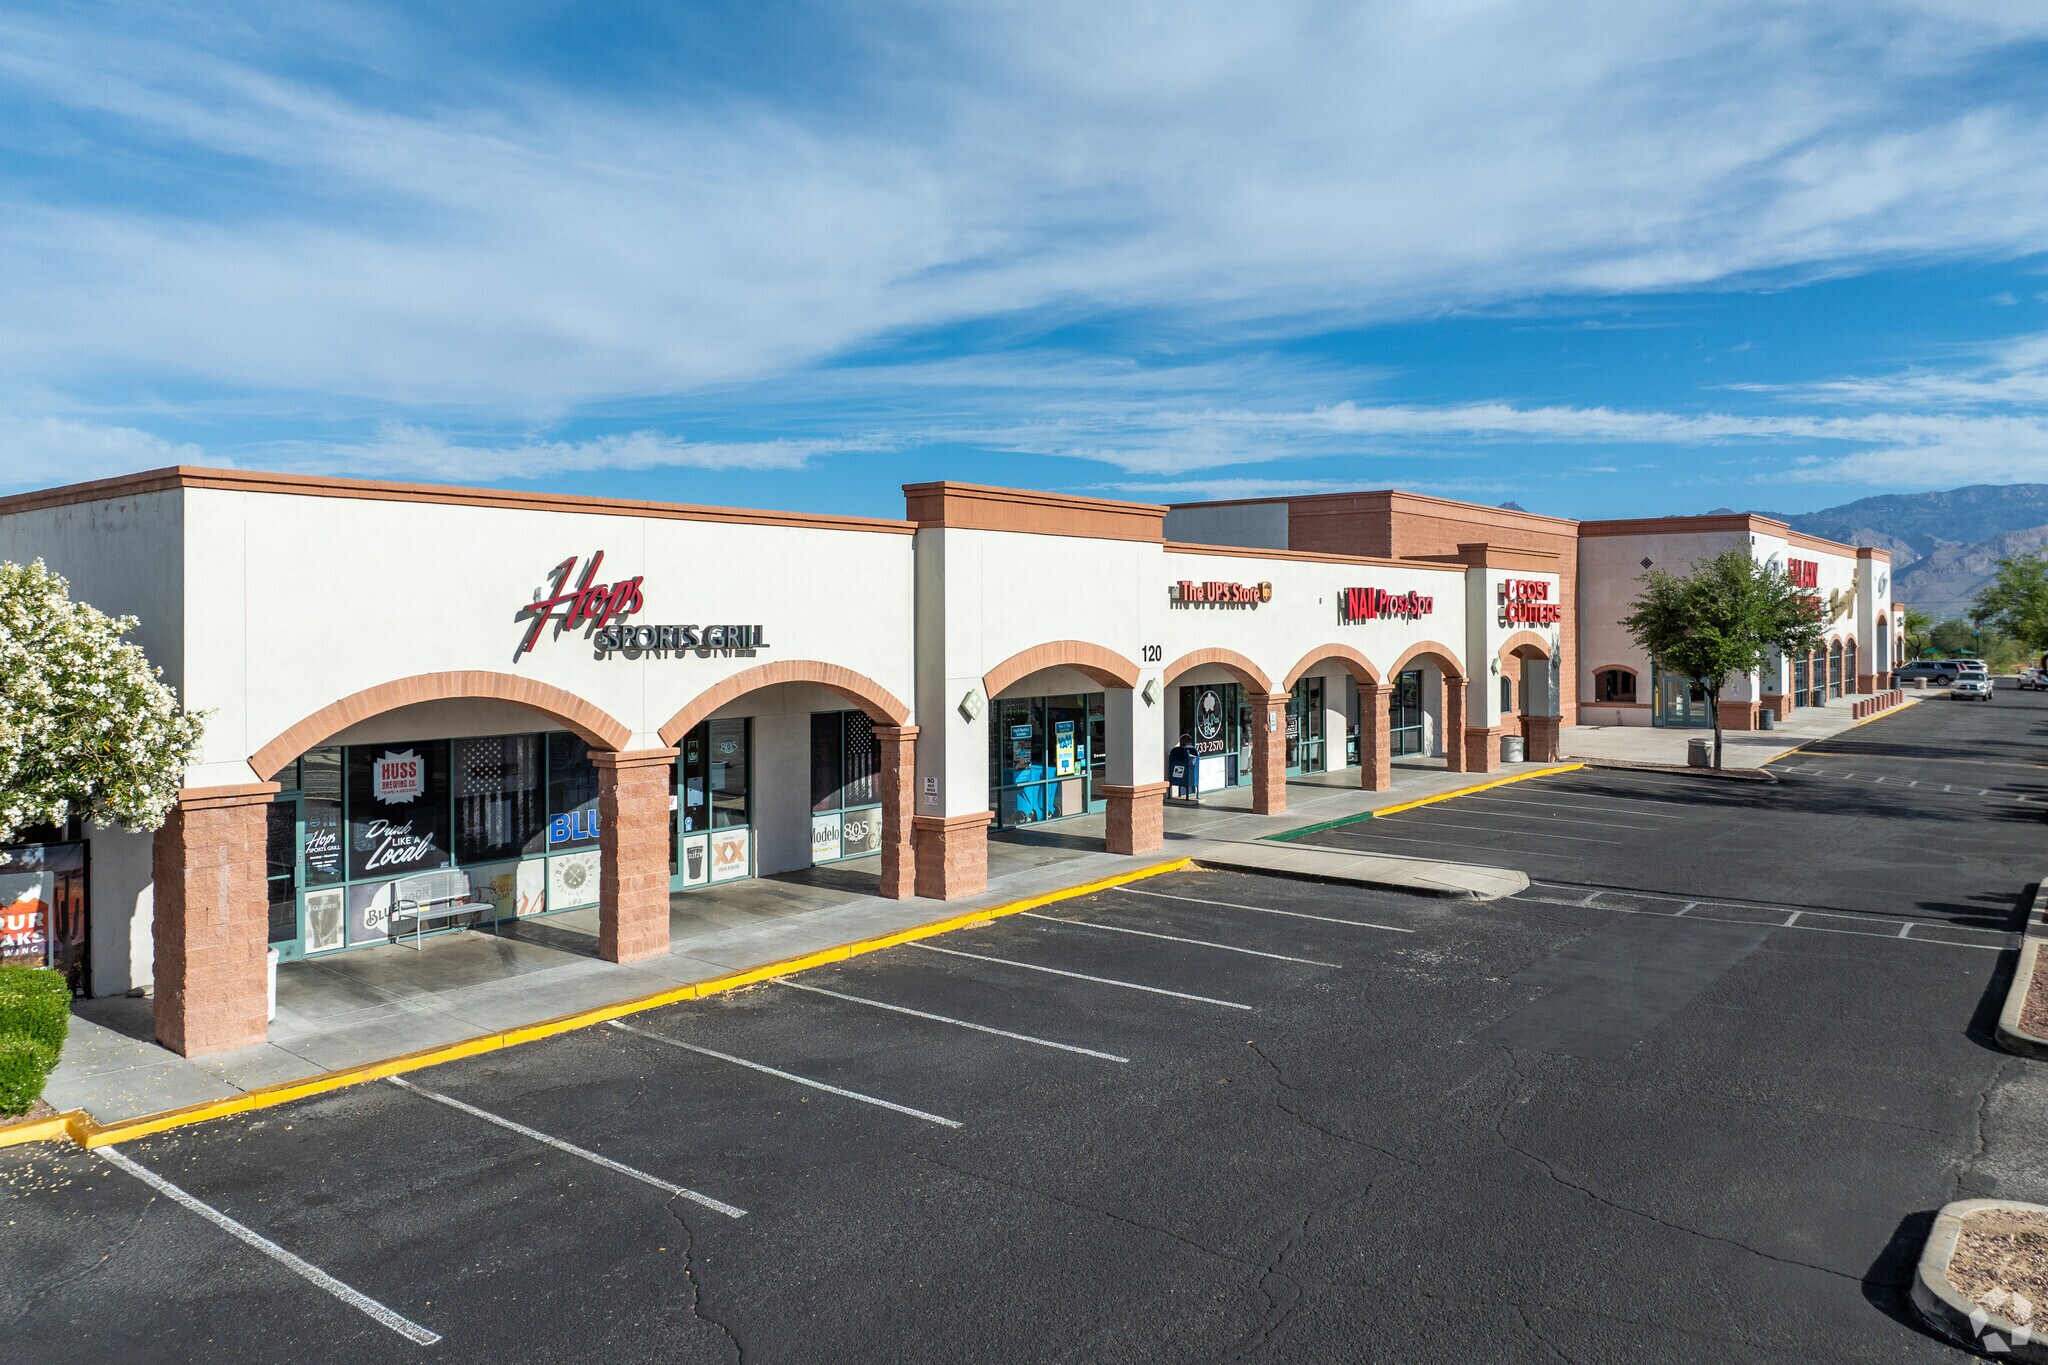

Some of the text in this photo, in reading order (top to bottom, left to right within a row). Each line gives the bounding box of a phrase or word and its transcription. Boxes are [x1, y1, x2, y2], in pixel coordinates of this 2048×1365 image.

[1180, 580, 1260, 602] The UPS Store
[1516, 580, 1551, 600] COST
[521, 549, 644, 653] Hops
[1347, 587, 1377, 619] NAIL
[1379, 589, 1404, 614] Pros
[1411, 590, 1433, 620] Spa
[1507, 603, 1562, 622] CUTTERS
[604, 624, 771, 650] SPORTS GRILL
[1142, 644, 1162, 662] 120
[720, 740, 738, 752] 805
[1195, 740, 1224, 753] 733-2570
[381, 761, 417, 780] HUSS
[381, 779, 417, 790] BREWING CO.
[365, 819, 413, 838] Drink
[550, 808, 600, 844] BLU
[844, 820, 869, 838] 805
[305, 828, 336, 854] Hops
[392, 836, 421, 847] LIKE A
[365, 832, 434, 870] Local
[712, 839, 746, 867] XX
[492, 892, 511, 901] LGHT
[365, 901, 400, 927] BLUE
[0, 930, 45, 947] AKS
[3, 945, 39, 957] WING
